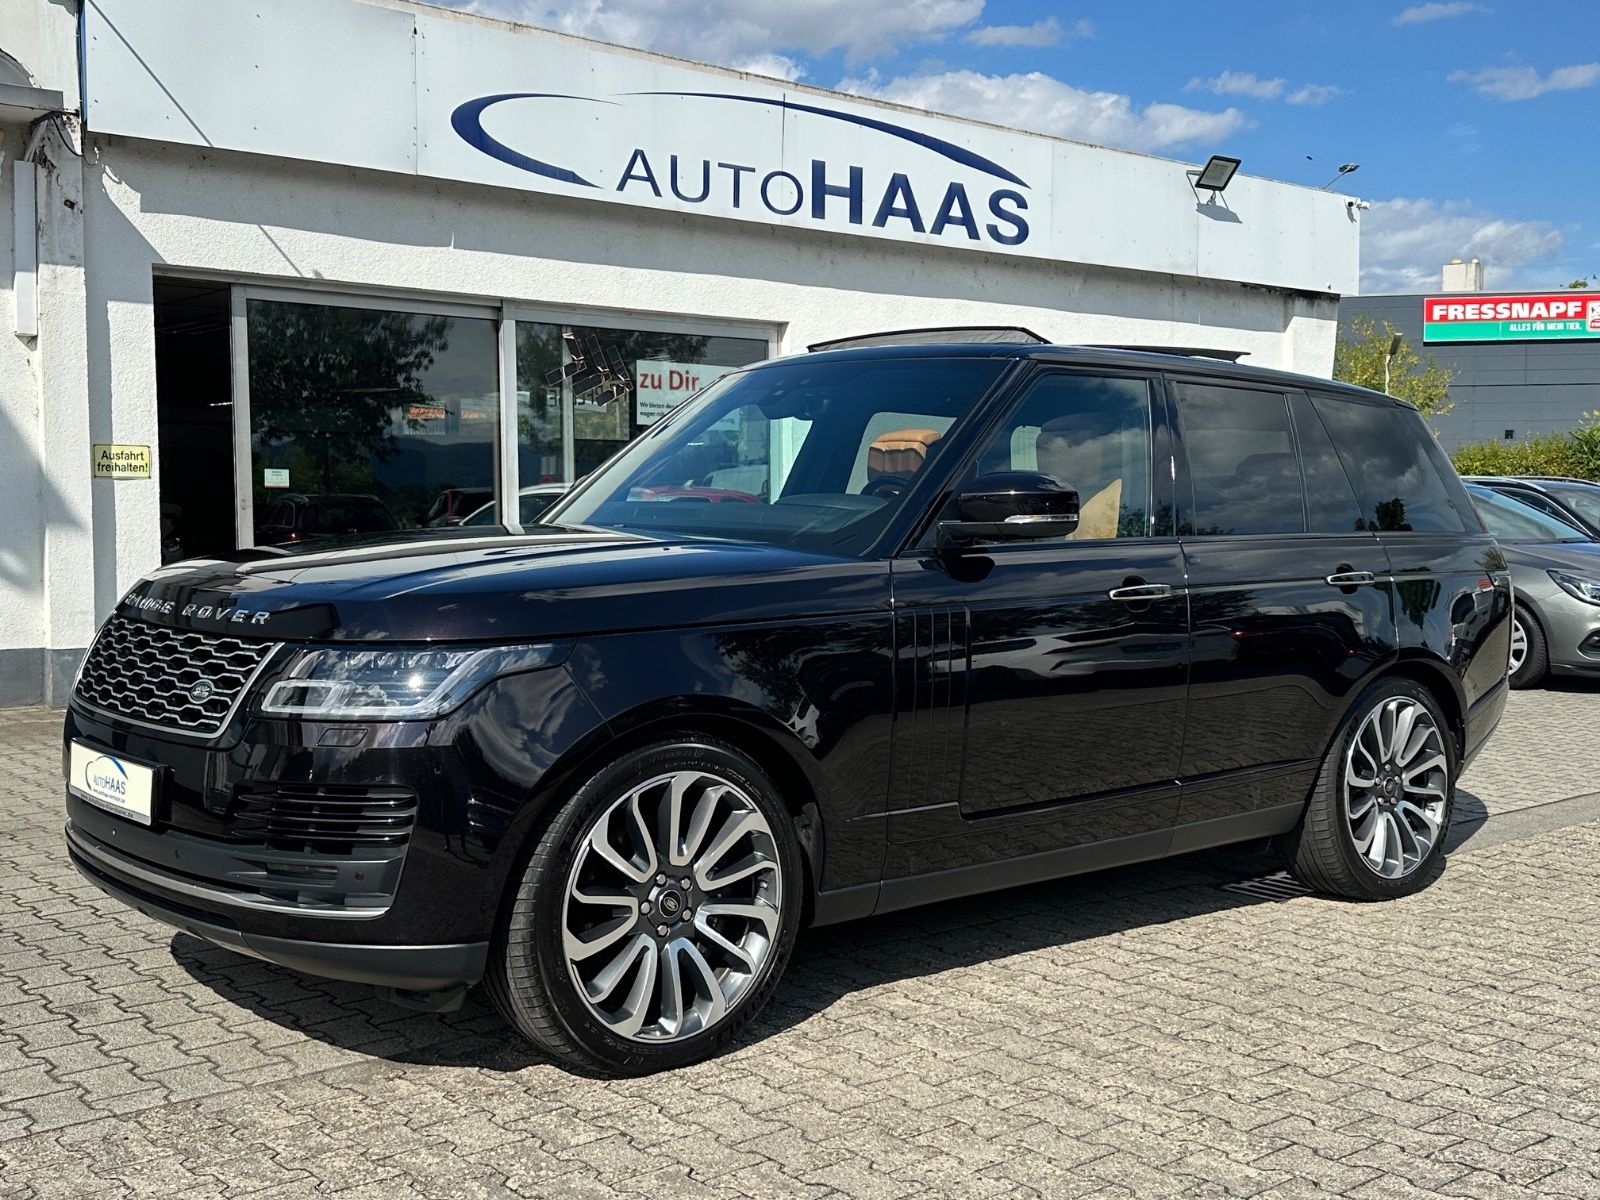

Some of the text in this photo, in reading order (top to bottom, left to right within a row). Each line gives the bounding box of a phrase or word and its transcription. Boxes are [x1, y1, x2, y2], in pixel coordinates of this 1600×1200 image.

[616, 148, 1030, 246] AUTOHAAS
[1432, 302, 1582, 320] FRESSNAPF
[1509, 323, 1531, 332] ALLES
[1532, 321, 1545, 331] FÜR
[1546, 322, 1564, 331] MEIN
[639, 373, 662, 389] zu
[101, 450, 144, 461] Ausfahrt
[97, 462, 148, 473] freihalten!
[182, 603, 271, 625] ROVER
